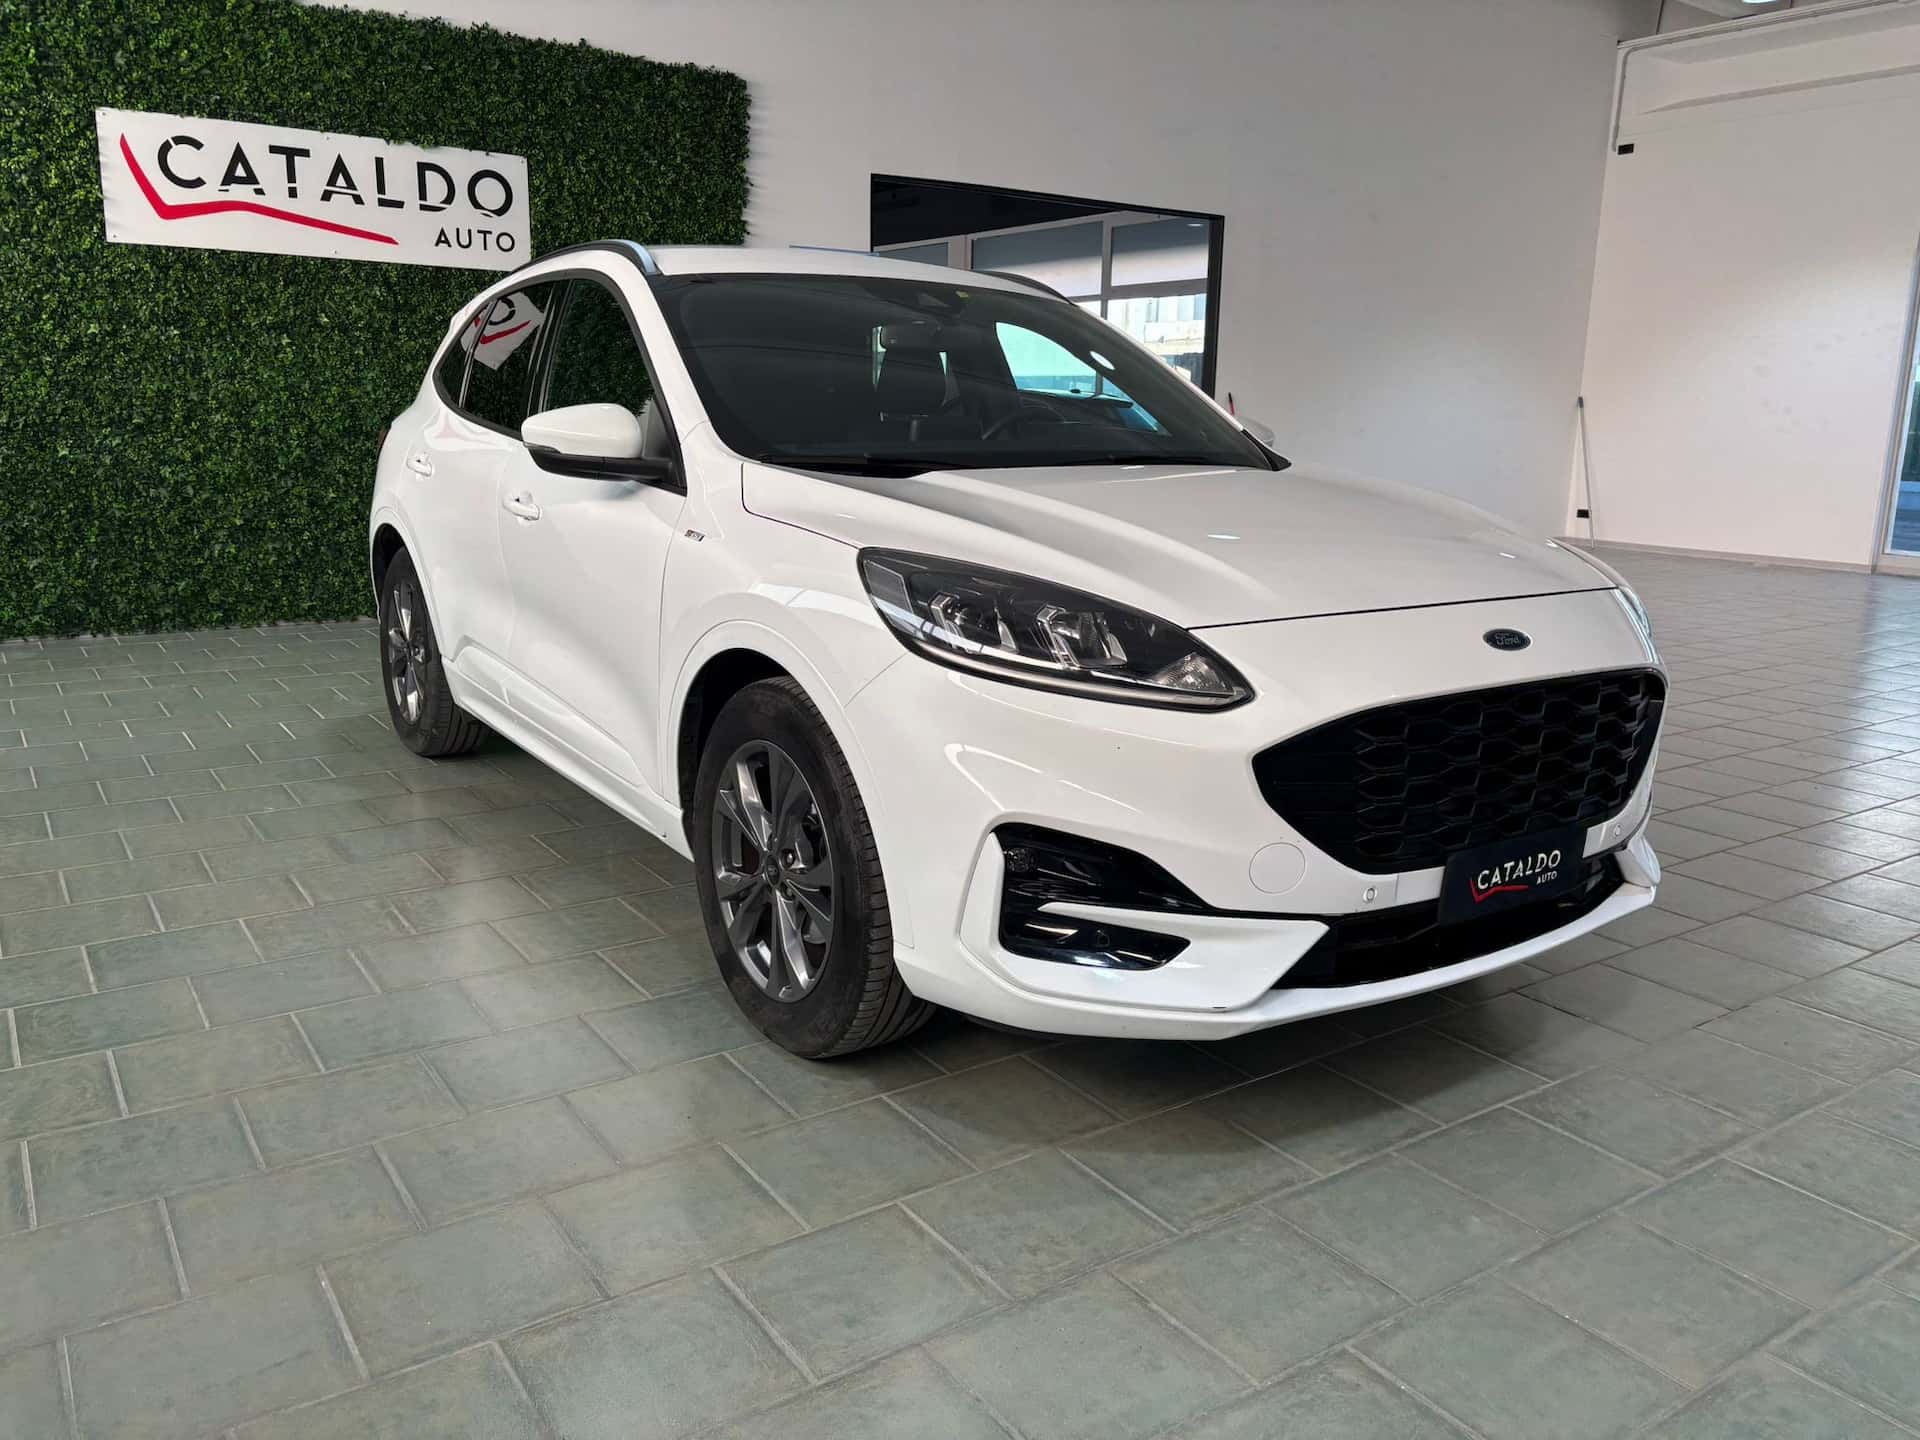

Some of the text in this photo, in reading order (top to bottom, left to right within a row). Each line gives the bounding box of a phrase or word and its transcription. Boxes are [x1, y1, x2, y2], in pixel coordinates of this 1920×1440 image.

[157, 135, 513, 217] CATALDO
[434, 227, 515, 253] AUTO
[1477, 850, 1561, 890] CATALDO
[1536, 870, 1558, 885] AUTO
